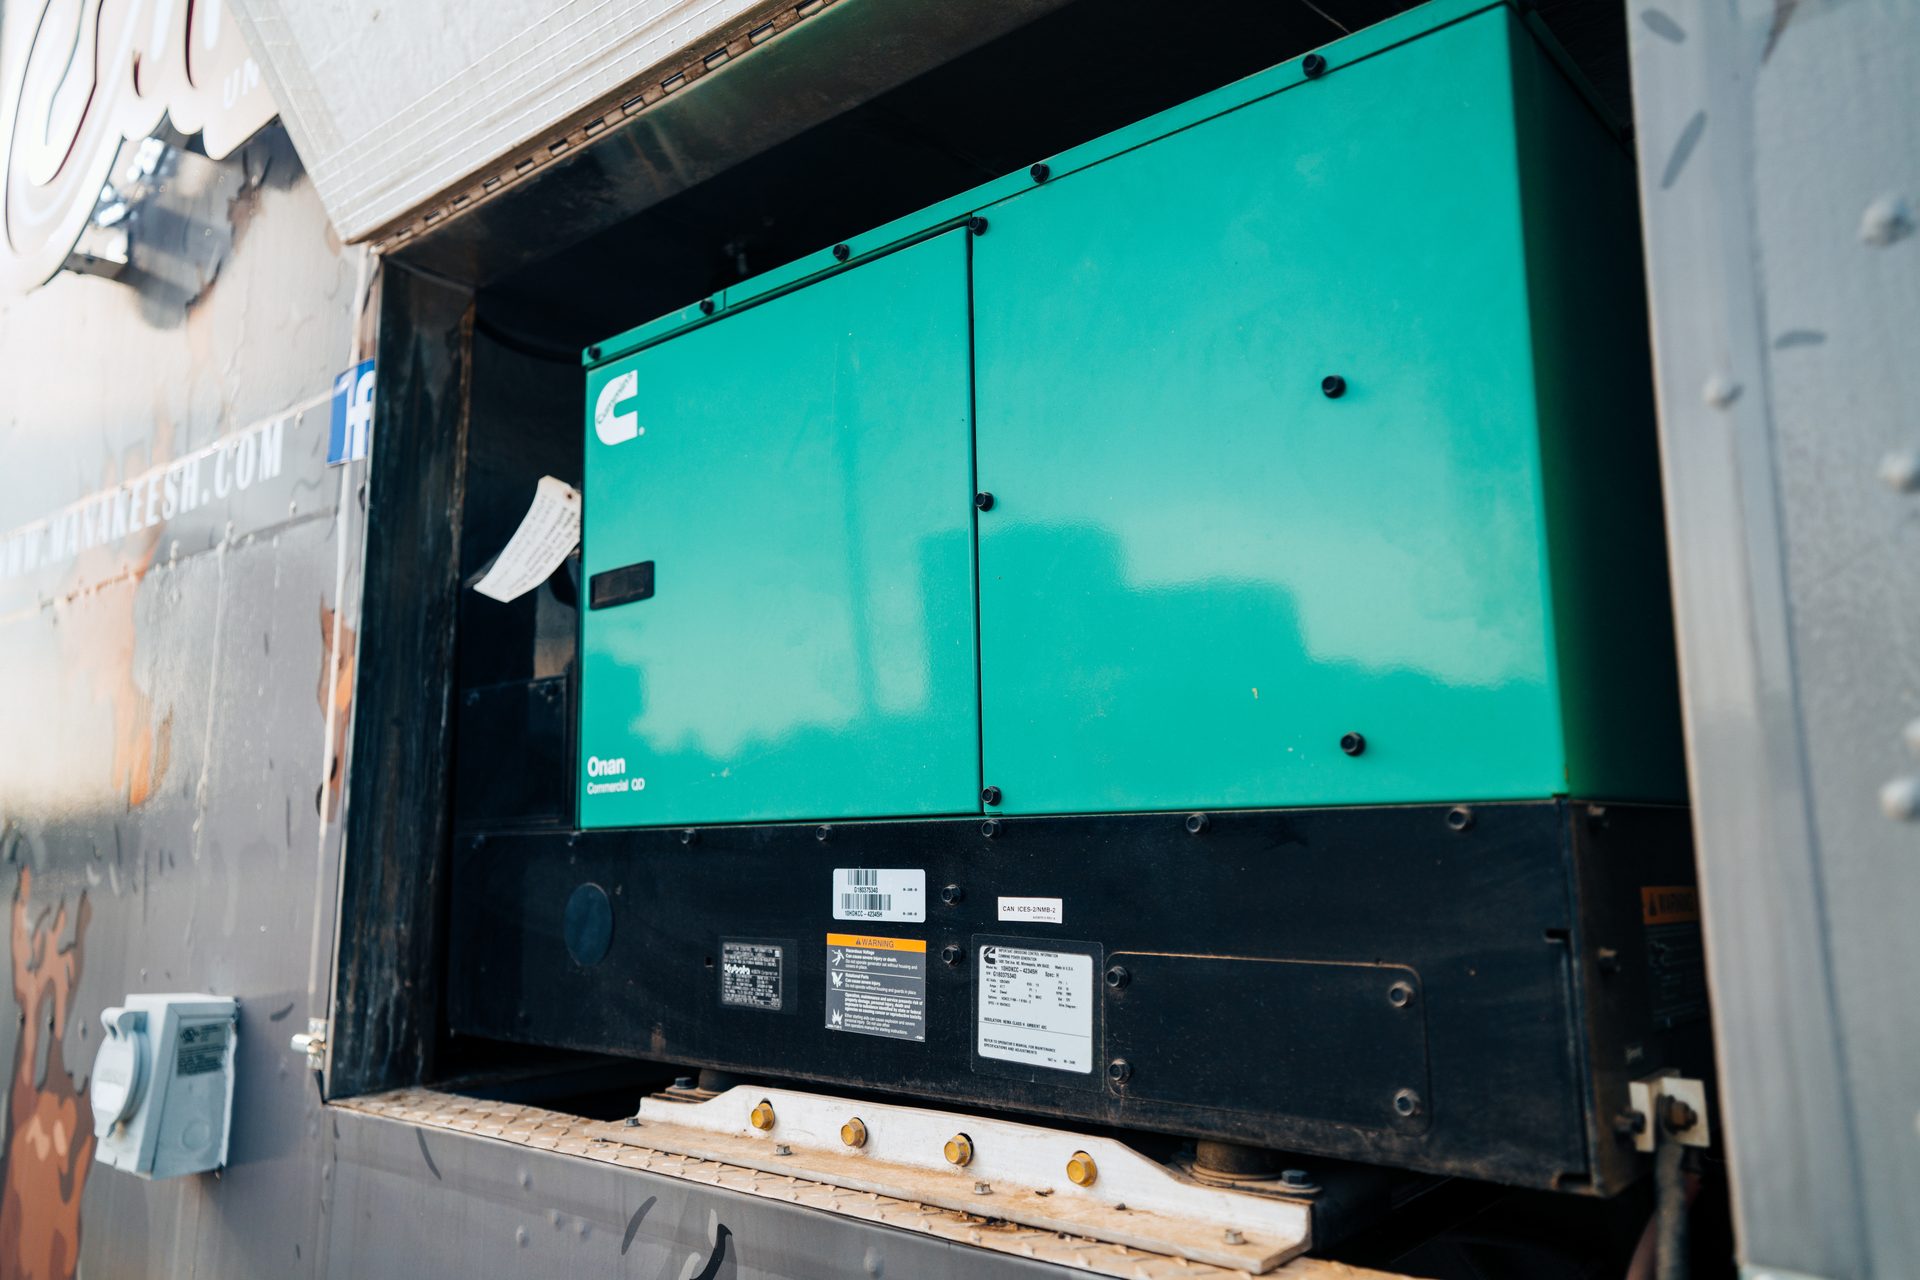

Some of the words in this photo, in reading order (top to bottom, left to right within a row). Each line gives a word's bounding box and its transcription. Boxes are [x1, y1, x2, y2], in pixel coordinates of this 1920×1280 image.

[588, 756, 626, 777] Onan
[862, 938, 894, 949] WARNING
[725, 964, 750, 975] Kubota
